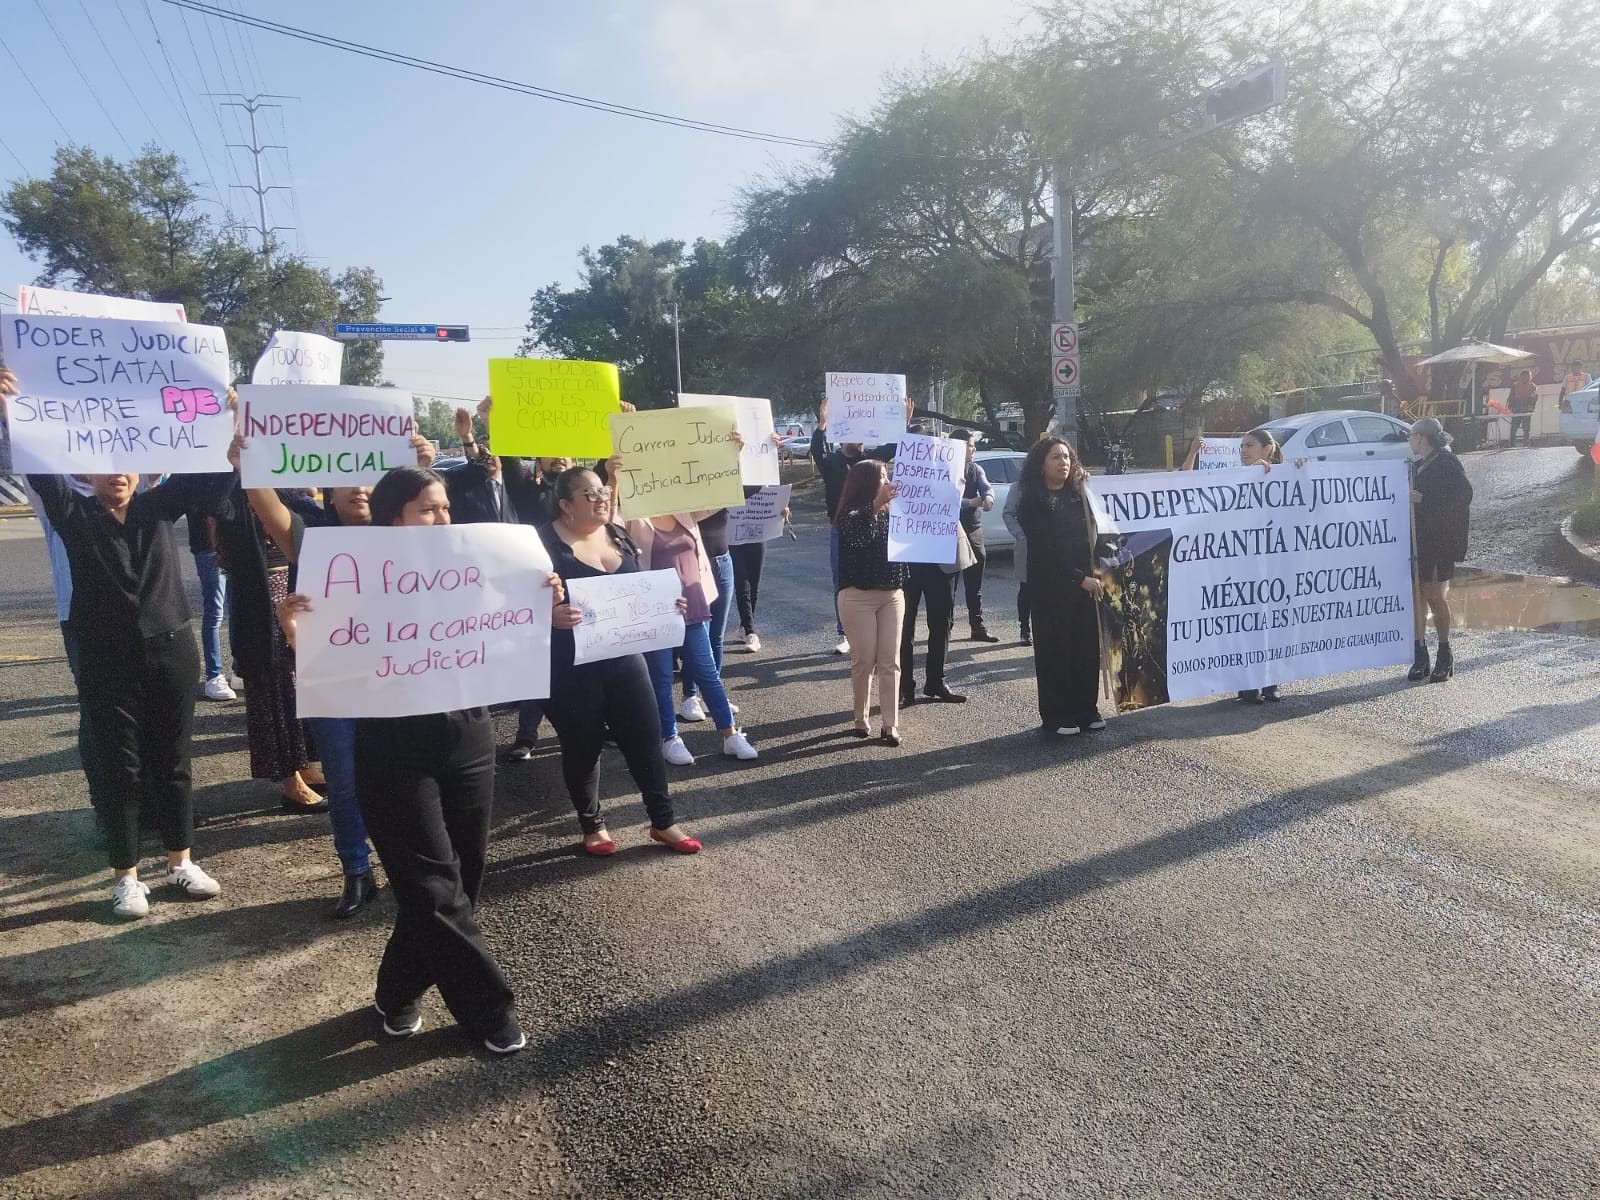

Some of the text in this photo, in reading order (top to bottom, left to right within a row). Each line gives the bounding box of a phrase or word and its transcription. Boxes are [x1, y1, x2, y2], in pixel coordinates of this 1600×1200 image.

[15, 319, 224, 354] PODER JUDICIAL
[57, 355, 191, 385] ESTATAL
[271, 347, 313, 369] TODOS
[506, 360, 529, 375] EL
[512, 377, 608, 391] JUDICIAL
[517, 391, 585, 407] NO ES
[15, 386, 221, 424] SIEMPRE PJE
[244, 401, 414, 437] INDEPENDENCIA
[67, 425, 208, 453] IMPARCIAL
[271, 443, 394, 474] JUDICIAL
[896, 462, 950, 481] DESPIERTA
[621, 460, 740, 499] Justicia Imparcial
[895, 480, 934, 498] PODER
[903, 501, 952, 517] JUDICIAL
[1102, 475, 1396, 523] INDEPENDENCIA JUDICIAL,
[891, 515, 958, 536] TE REPRESENTA
[1173, 518, 1397, 563] GARANTÍA NACIONAL.
[325, 552, 361, 599] A
[1200, 565, 1382, 610] MÉXICO, ESCUCHA,
[330, 617, 369, 645] de
[1171, 595, 1405, 643] TU JUSTICIA ES NUESTRA LUCHA.
[376, 642, 485, 677] Judicial
[1172, 657, 1206, 676] SOMOS
[1208, 652, 1243, 672] PODER
[1300, 638, 1332, 655] ESTADO
[1334, 635, 1346, 649] DE
[1347, 629, 1404, 647] GUANAJUATO.
